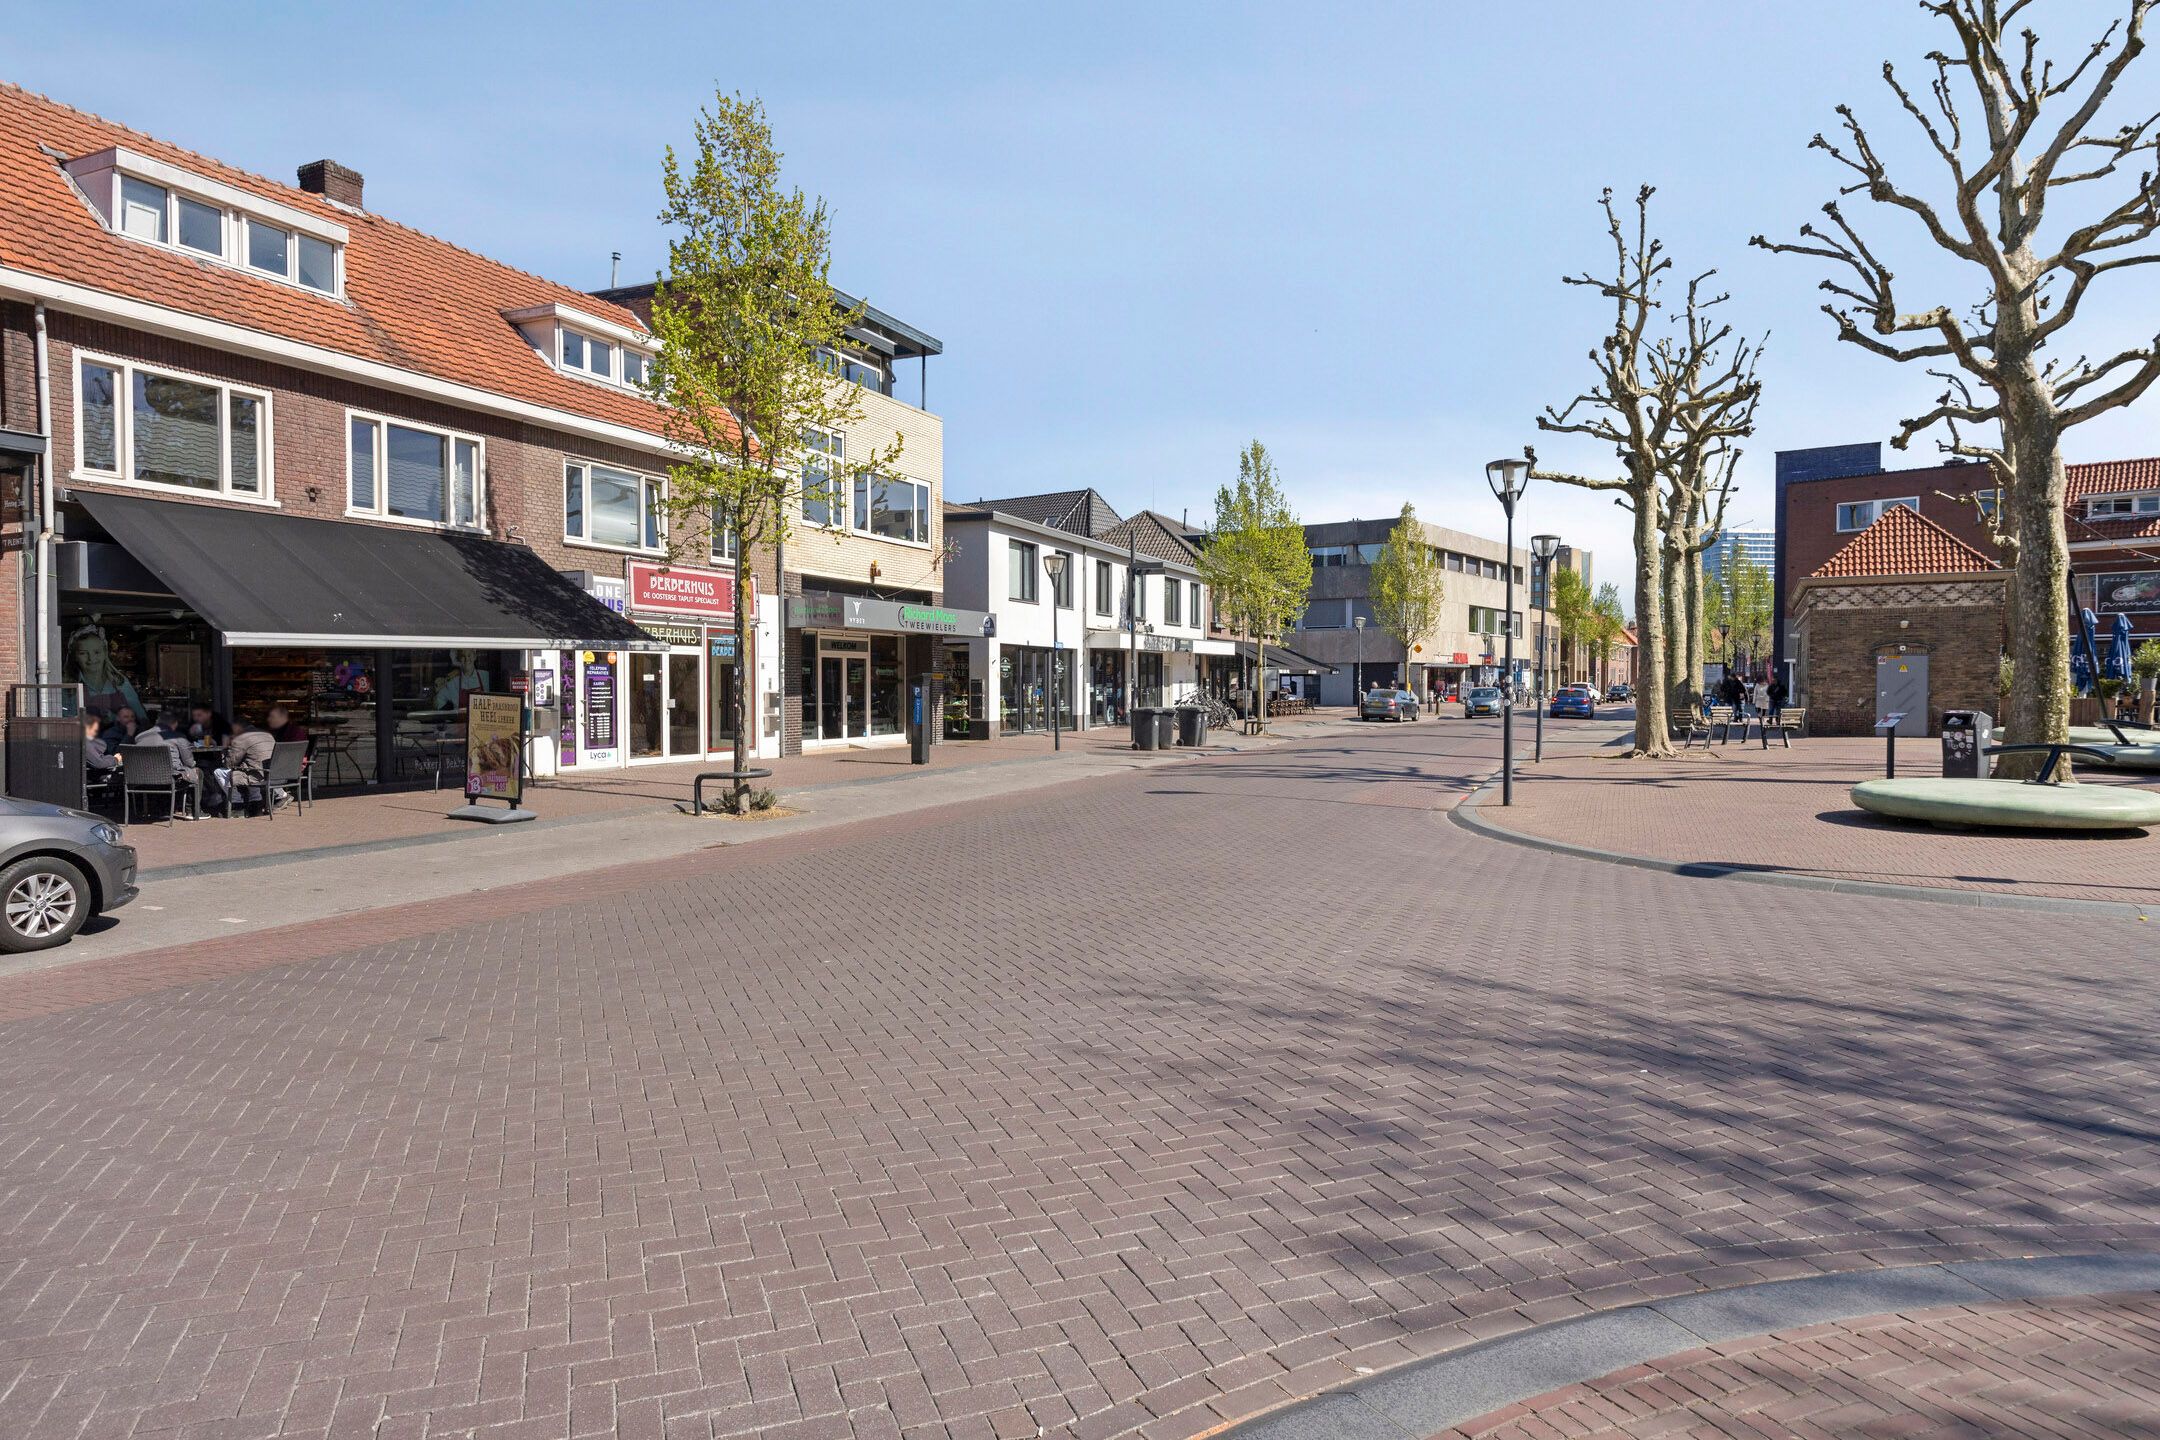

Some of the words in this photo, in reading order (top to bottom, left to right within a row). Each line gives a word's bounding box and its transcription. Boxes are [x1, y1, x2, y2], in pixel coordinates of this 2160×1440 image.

[650, 576, 715, 596] BERBERHUIS
[651, 592, 677, 601] OOSTERSE
[694, 597, 720, 605] SPECIALIST
[904, 608, 934, 621] Richard
[935, 609, 957, 623] Maas
[904, 621, 957, 632] TWEEWIELERS
[831, 641, 857, 650] WELKOM
[915, 687, 920, 695] P
[473, 699, 491, 710] HALF
[481, 711, 497, 723] HEEL
